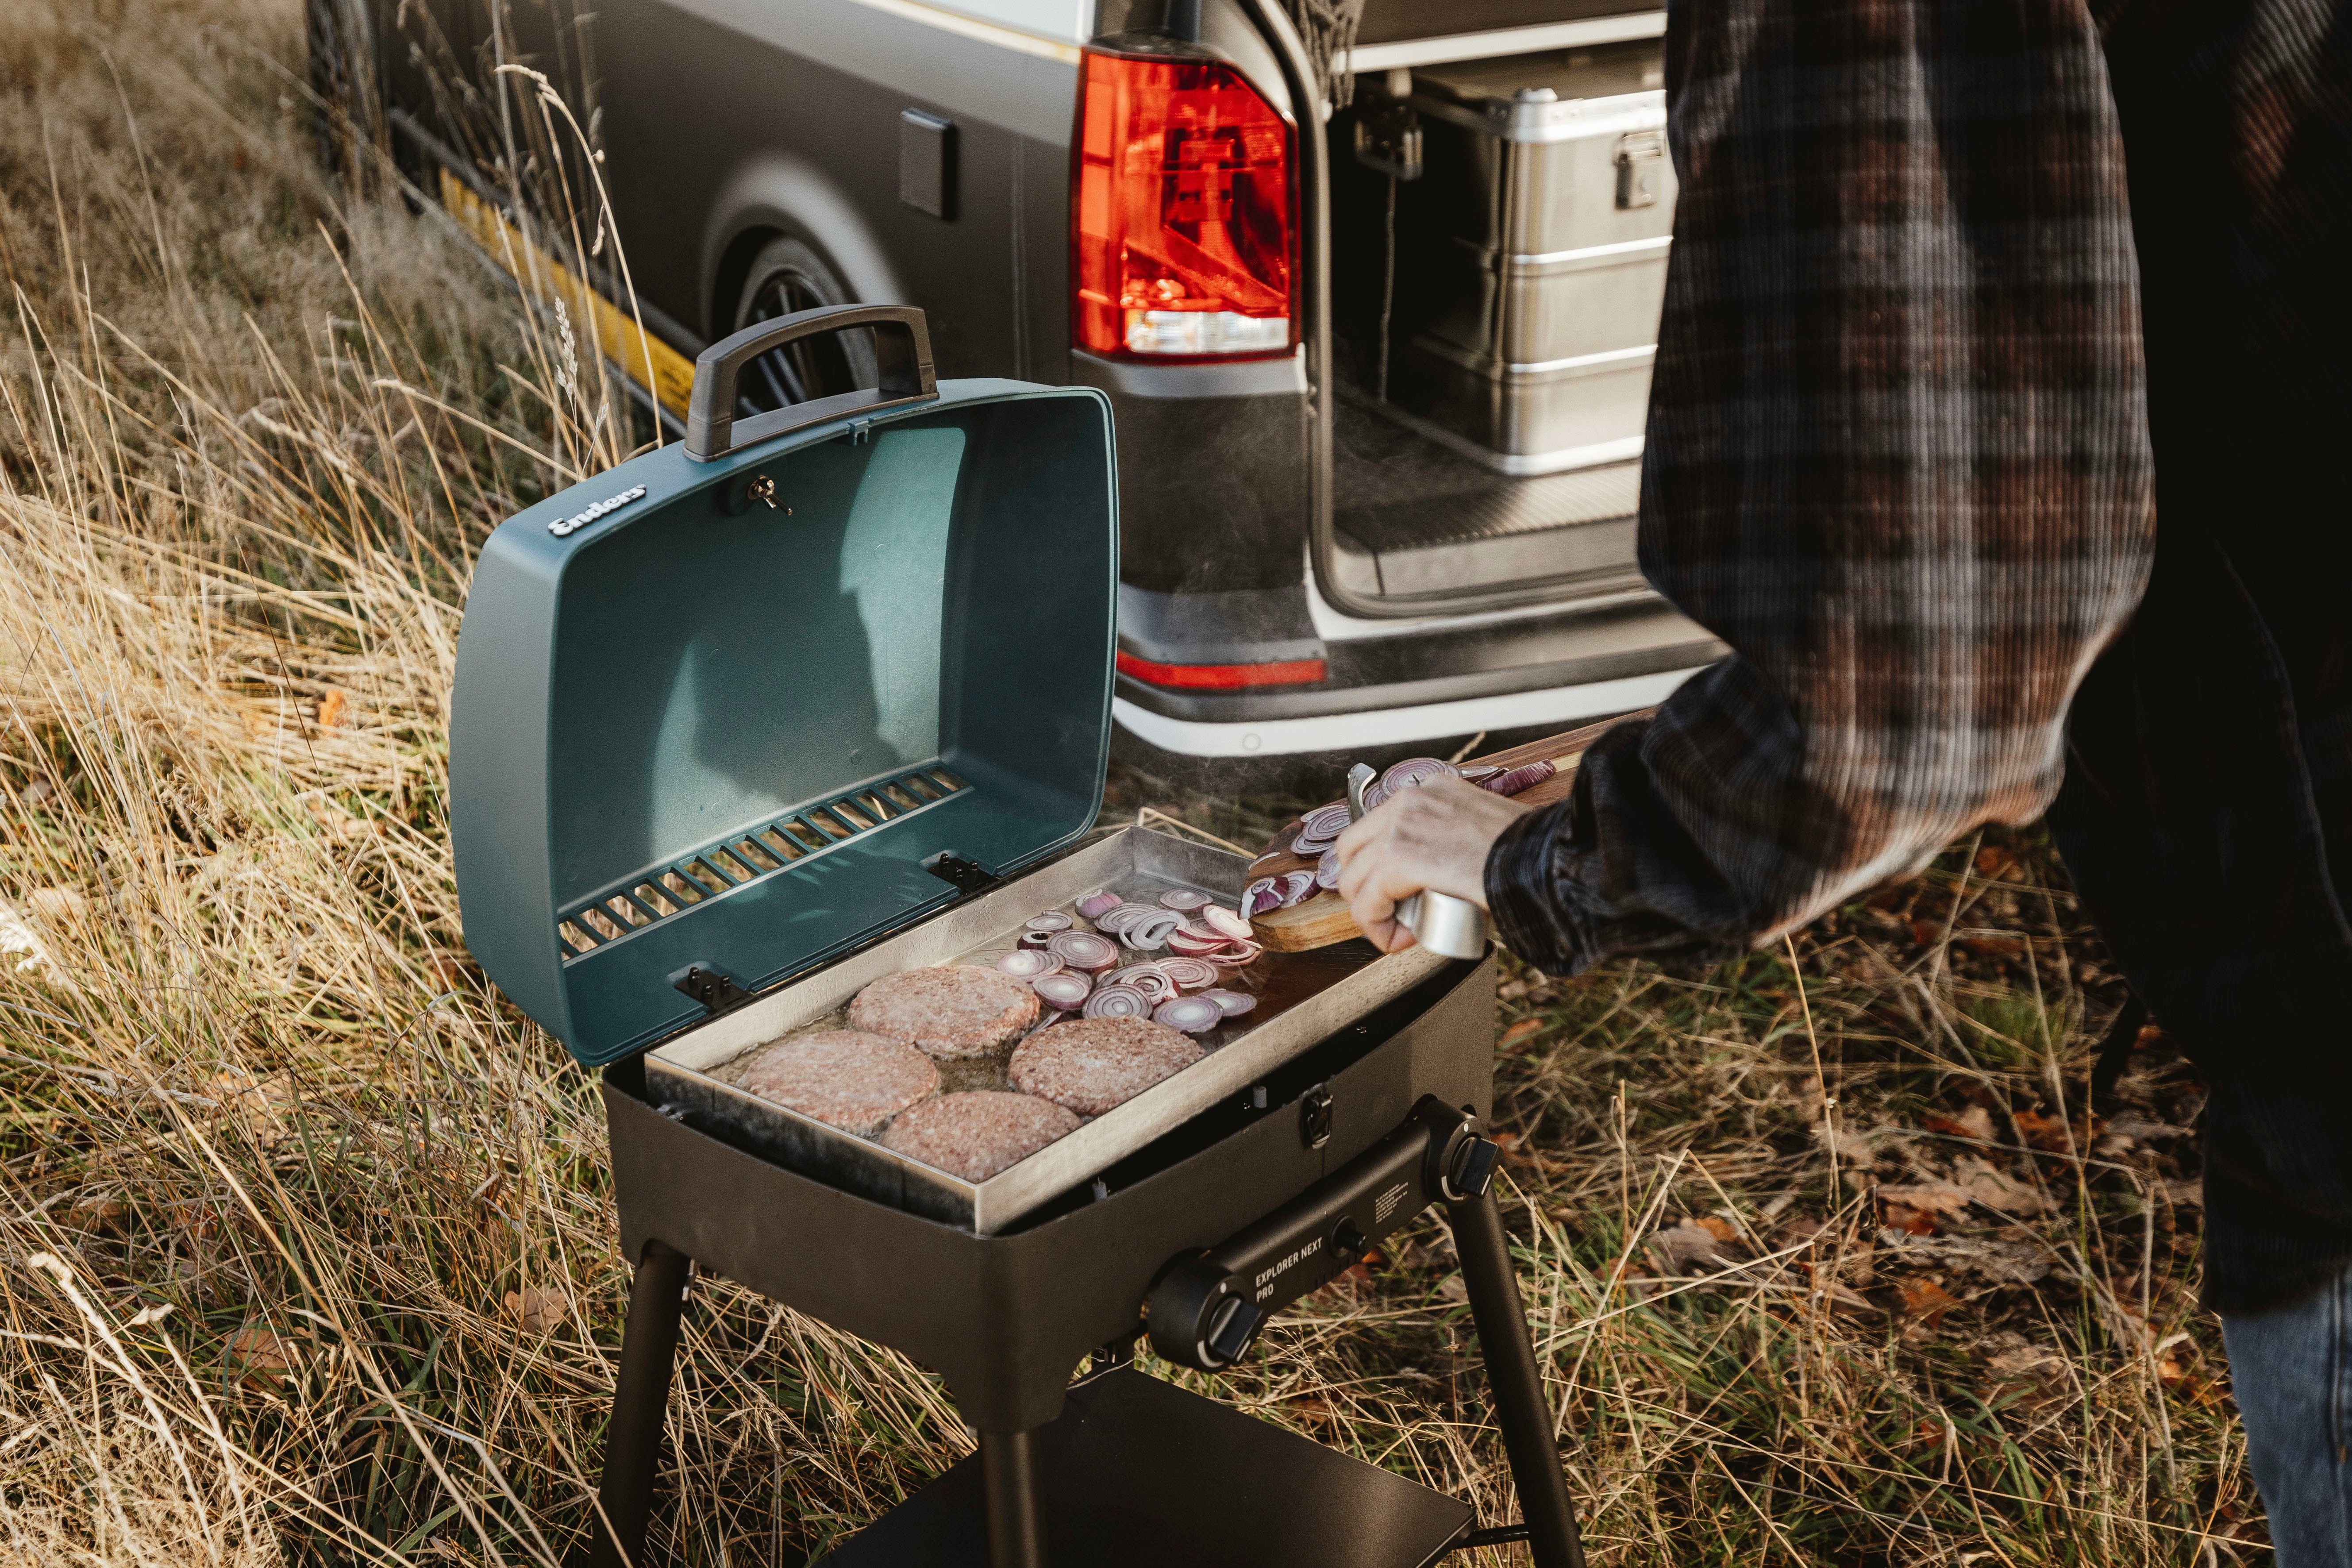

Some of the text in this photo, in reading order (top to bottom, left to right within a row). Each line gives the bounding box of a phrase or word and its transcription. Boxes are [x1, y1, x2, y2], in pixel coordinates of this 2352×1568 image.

[1255, 1237, 1322, 1287] EXPLORER NEXT
[1256, 1283, 1274, 1303] PRO
